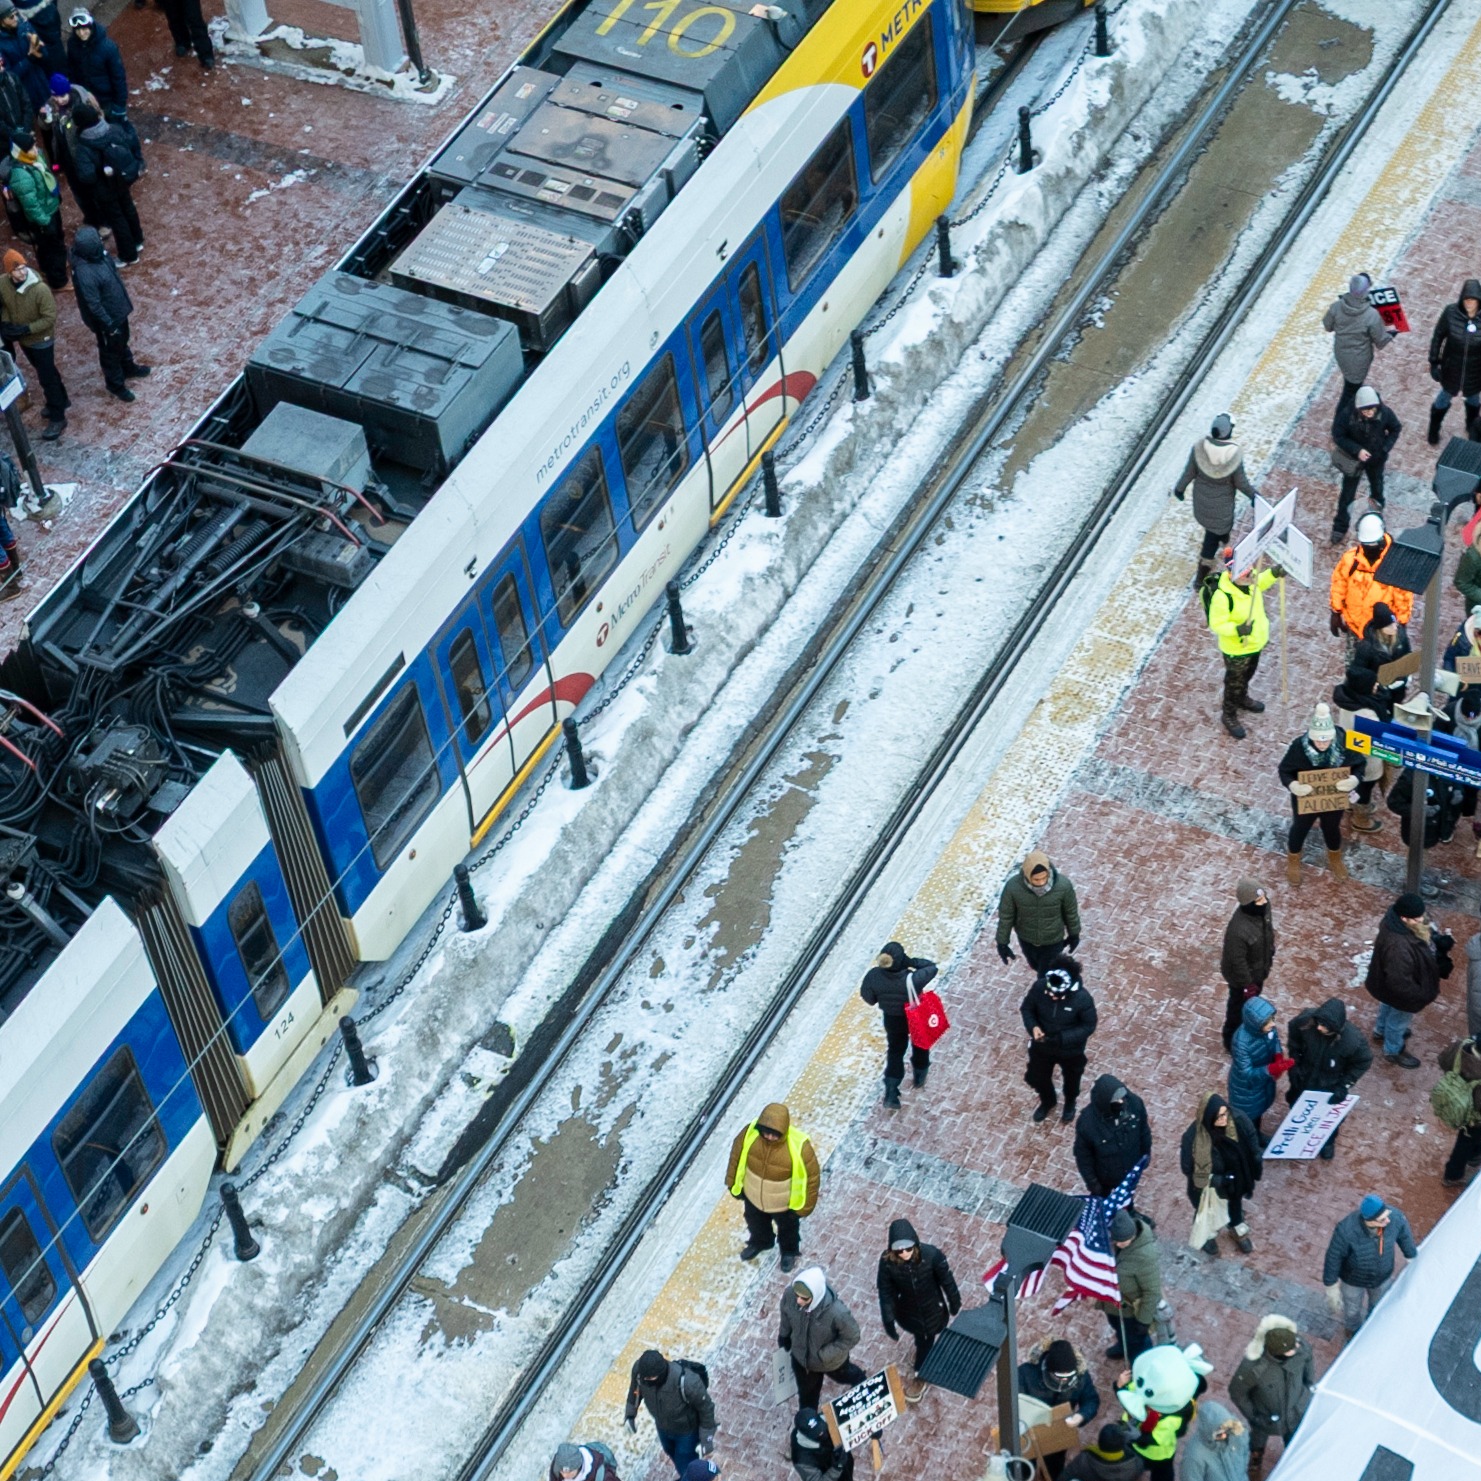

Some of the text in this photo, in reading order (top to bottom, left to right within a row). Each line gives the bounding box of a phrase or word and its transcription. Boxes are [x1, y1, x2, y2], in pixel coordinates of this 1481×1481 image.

[534, 359, 632, 484] metrotransit.org
[1415, 763, 1453, 779] downtown
[1304, 798, 1345, 811] ALONE
[273, 1011, 296, 1040] 124
[1292, 1100, 1317, 1124] Good
[1301, 1130, 1320, 1156] ICE
[847, 1414, 893, 1447] FUCK OFF
